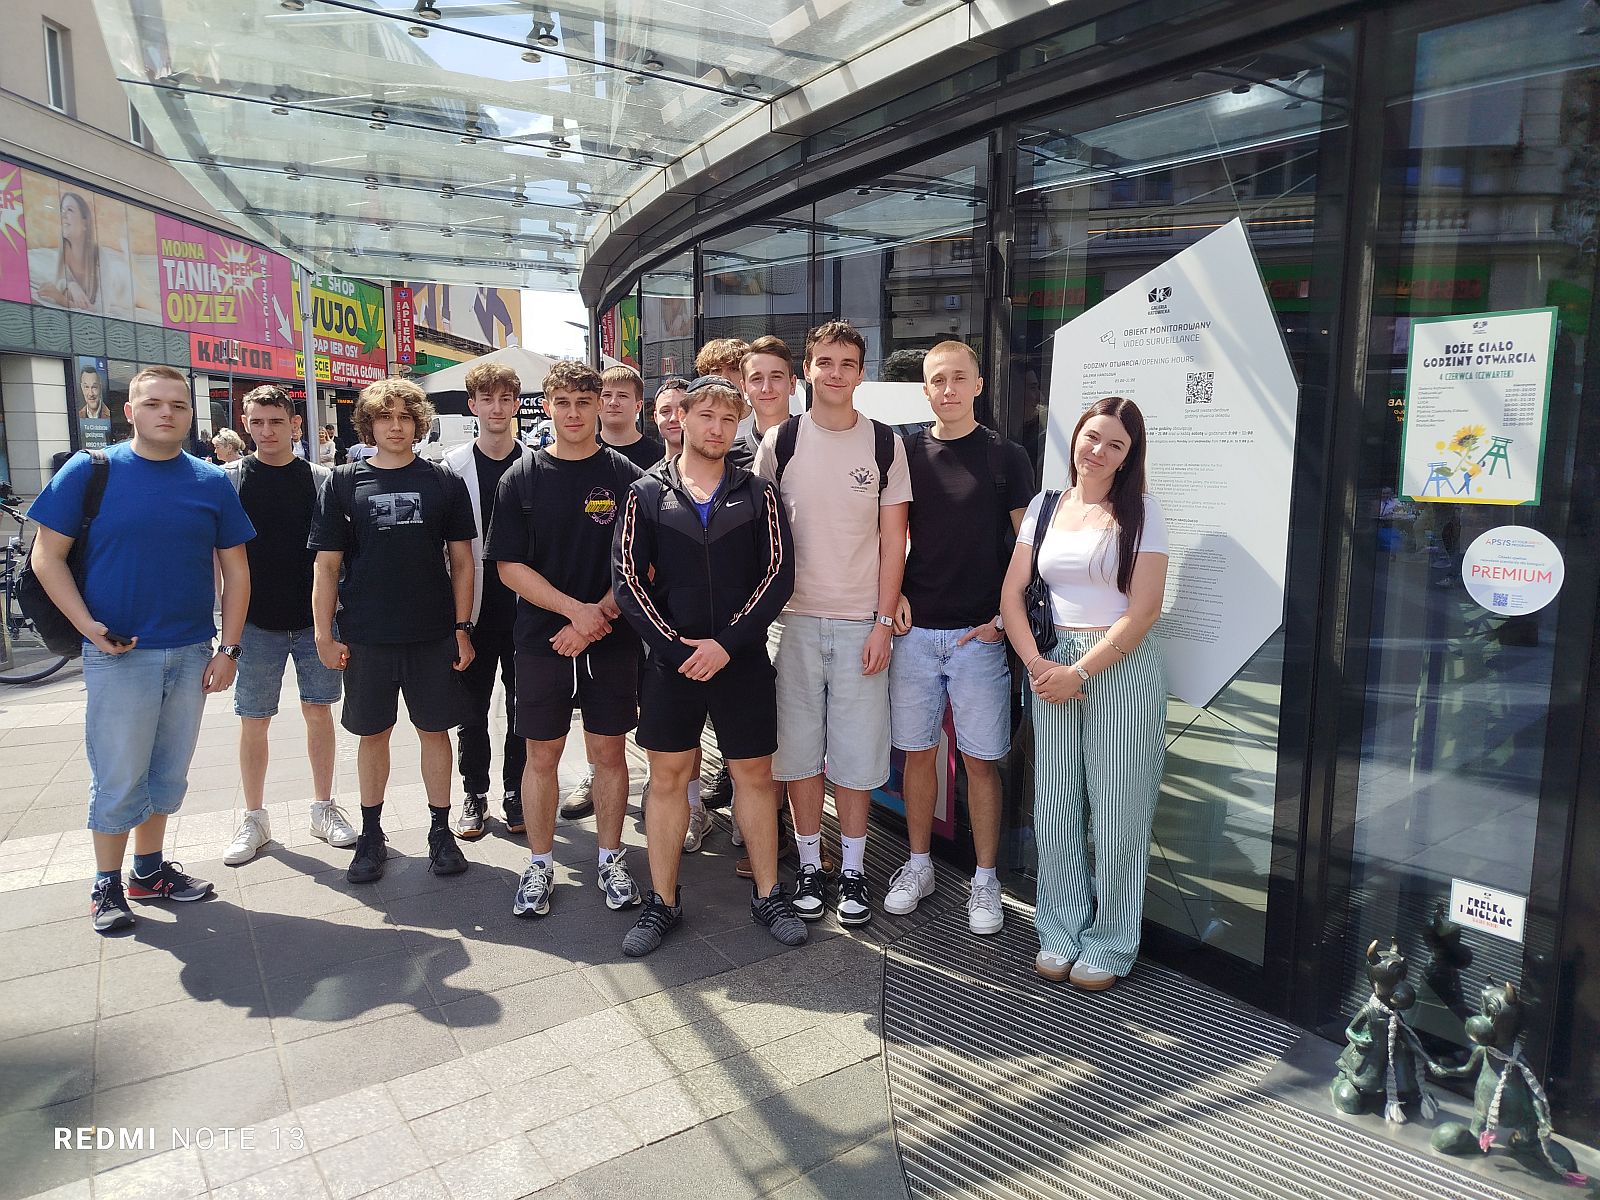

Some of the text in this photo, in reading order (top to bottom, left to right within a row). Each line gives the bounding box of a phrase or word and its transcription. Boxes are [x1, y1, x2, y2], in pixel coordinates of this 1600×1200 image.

[161, 238, 205, 259] MODNA
[163, 259, 222, 293] TANIA
[291, 262, 355, 296] VPE SHOP
[402, 301, 411, 352] APTEKA
[1123, 321, 1212, 337] OBIEKT MONITOROWANY
[1123, 333, 1200, 348] VIDEO SURVEILLANCE
[1444, 340, 1514, 355] BOŻE CIAŁO
[197, 340, 273, 370] KATOR
[1083, 362, 1108, 370] GODZINY
[1171, 355, 1195, 363] HOURS
[1423, 352, 1537, 368] GODZINY OTWARCIA
[332, 361, 360, 378] APTEKA
[1445, 371, 1473, 381] CZERWCA
[1485, 538, 1511, 547] APSYS
[1471, 565, 1552, 584] PREMIUM
[1468, 897, 1506, 915] FRELKA
[1460, 904, 1463, 912] I
[1466, 906, 1513, 927] MIGLANC
